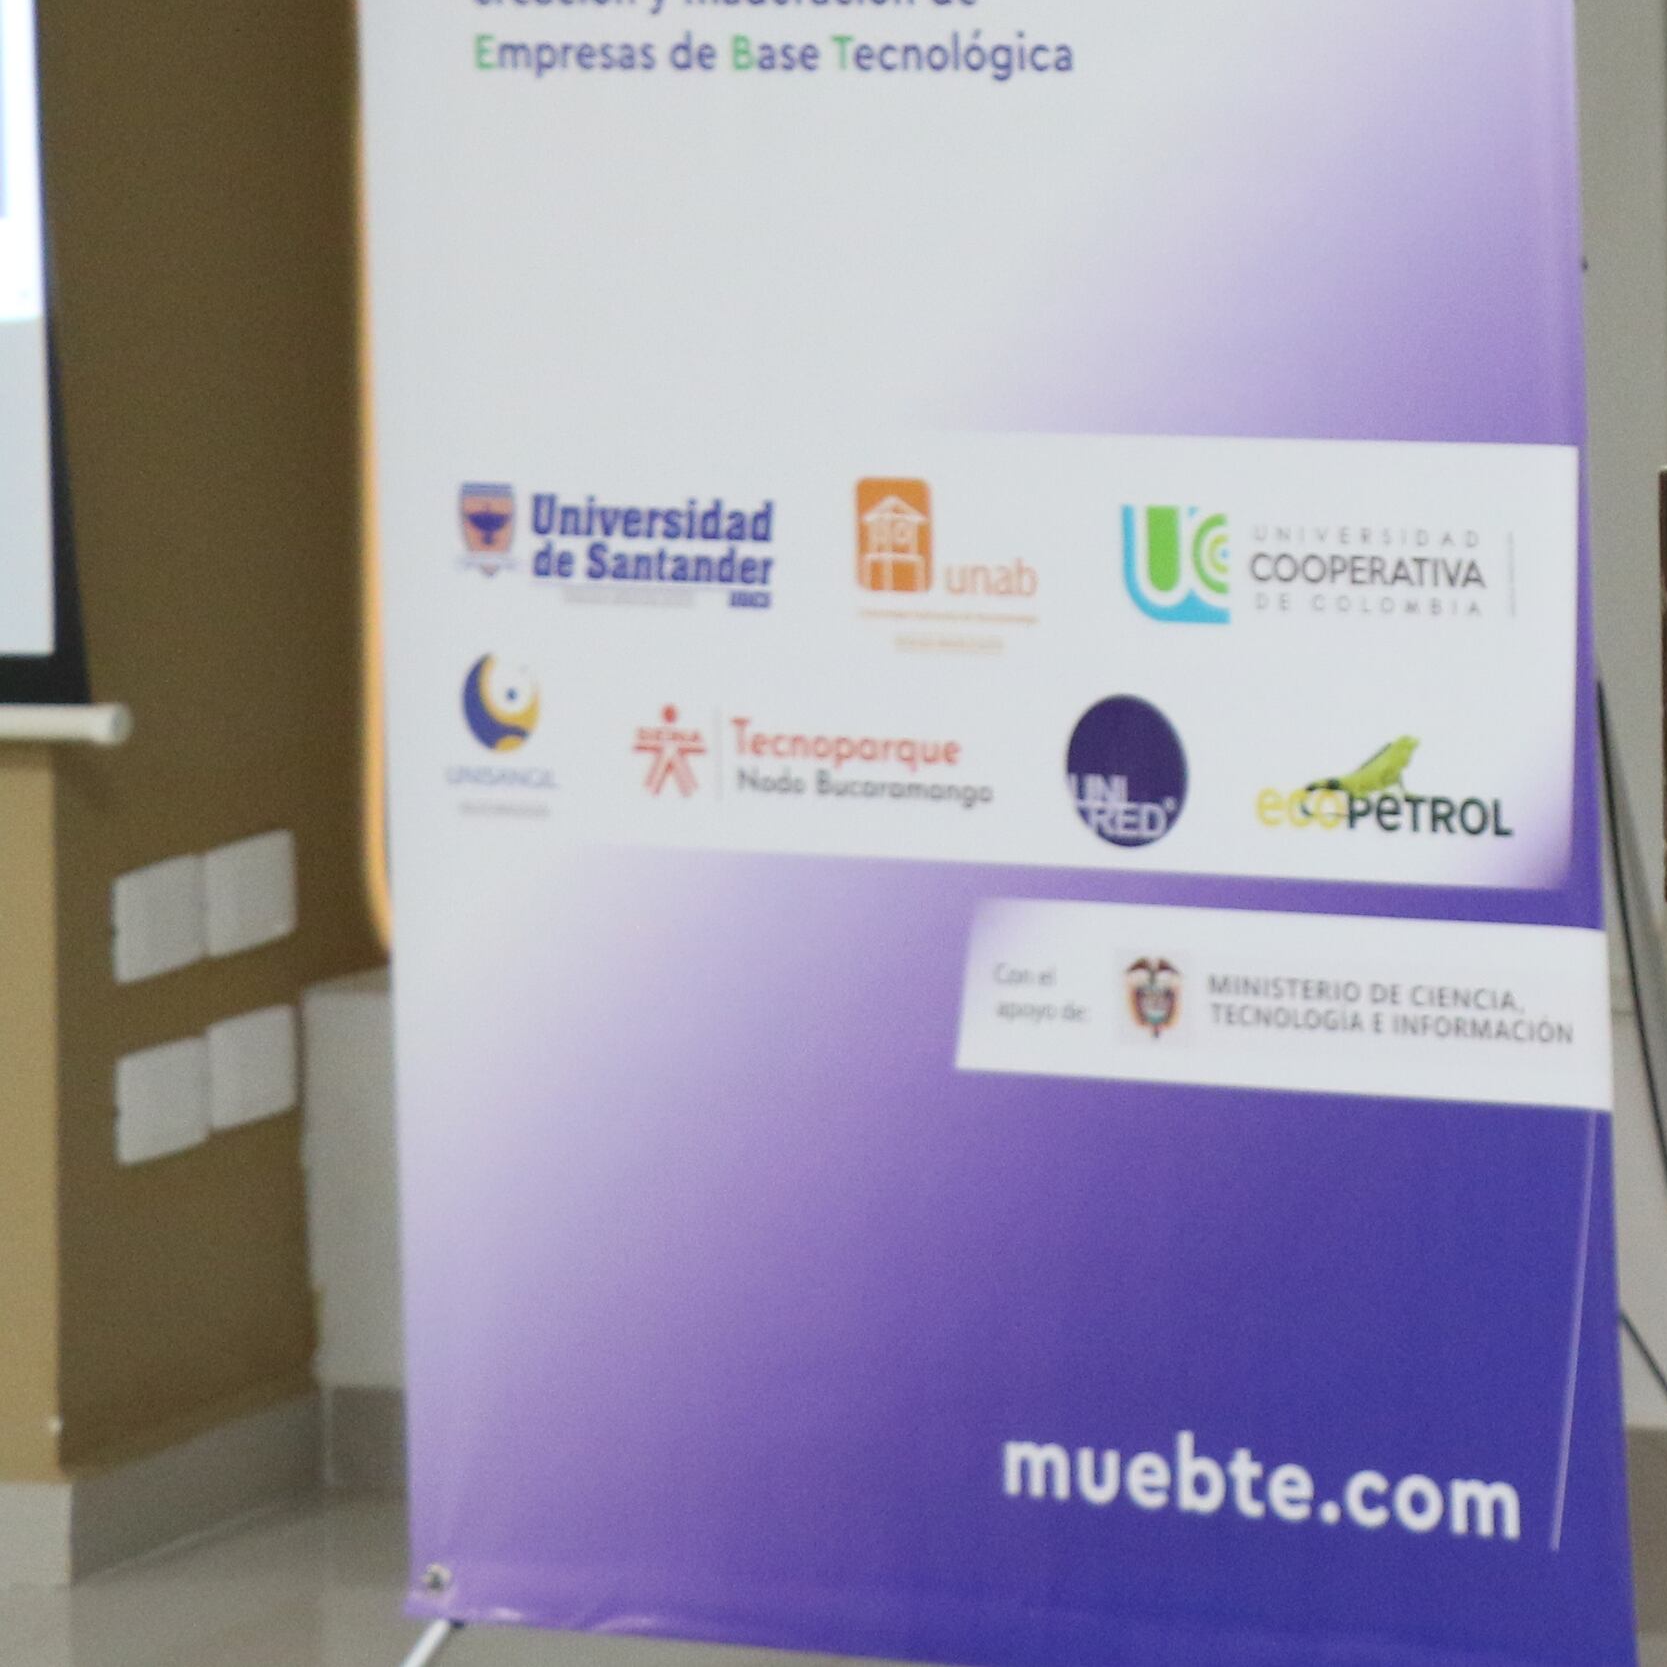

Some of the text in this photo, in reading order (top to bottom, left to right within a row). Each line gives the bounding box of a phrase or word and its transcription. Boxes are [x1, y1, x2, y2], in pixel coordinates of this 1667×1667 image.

[475, 28, 1074, 81] Empresas de Base Tecnológica
[531, 493, 774, 542] Universidad
[1254, 525, 1480, 548] UNIVERSIDAD
[533, 542, 574, 578] de
[586, 542, 774, 585] Santander
[944, 560, 1038, 596] unab
[1249, 552, 1485, 589] COOPERATIVA
[1256, 593, 1482, 617] DE COLOMBIA
[731, 718, 961, 772] Tecnoparque
[738, 768, 993, 809] Nodo Bucaramanga
[1208, 974, 1525, 1014] MINISTERIO DE CIENCIA,
[1211, 1002, 1575, 1044] TECNOLOGÍA E INFORMACIÓN
[1004, 1430, 1520, 1540] muebte.com
